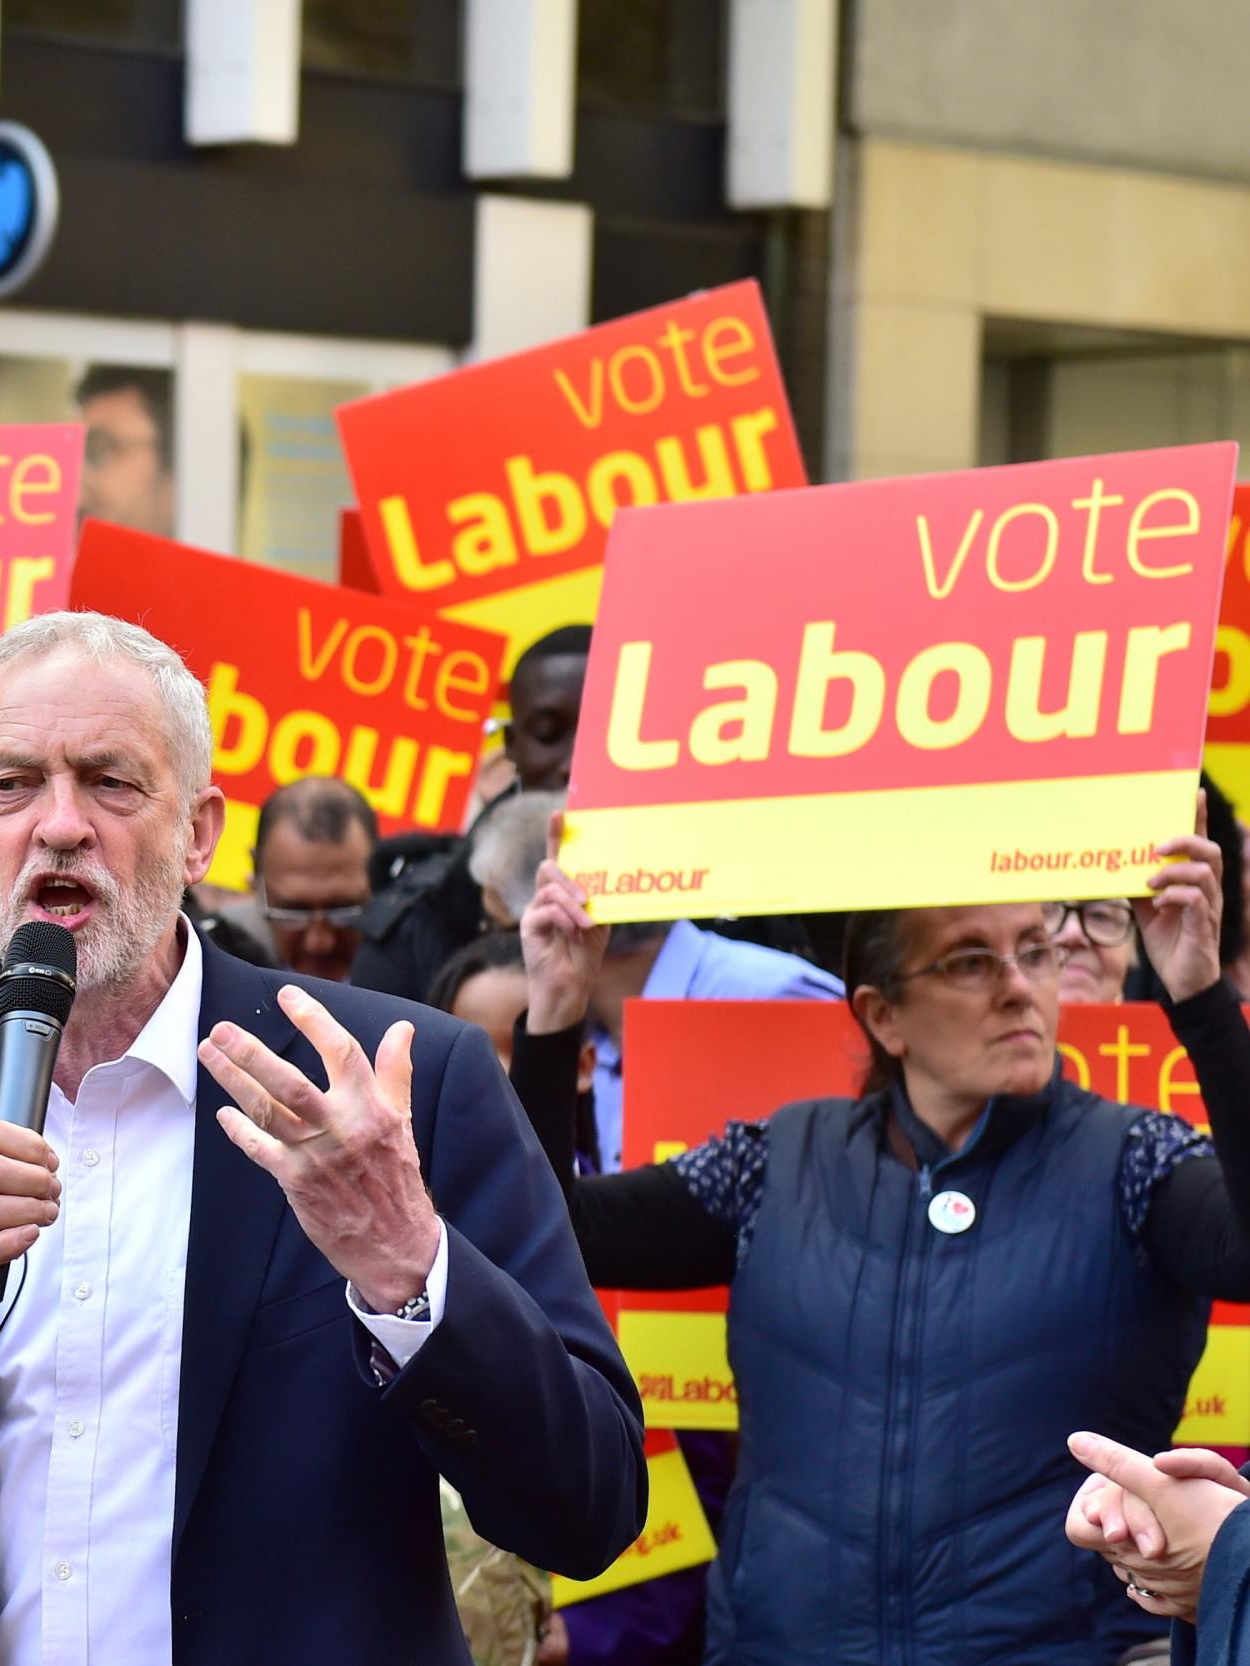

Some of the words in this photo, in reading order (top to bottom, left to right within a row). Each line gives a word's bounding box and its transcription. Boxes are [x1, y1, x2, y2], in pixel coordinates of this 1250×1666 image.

[552, 312, 762, 431] vote
[379, 406, 778, 592] Labour
[915, 478, 1201, 601] vote
[297, 607, 491, 724] vote
[605, 619, 1193, 772] Labour
[207, 662, 474, 828] bour
[599, 868, 711, 896] Labour
[990, 842, 1161, 873] labour.org.uk
